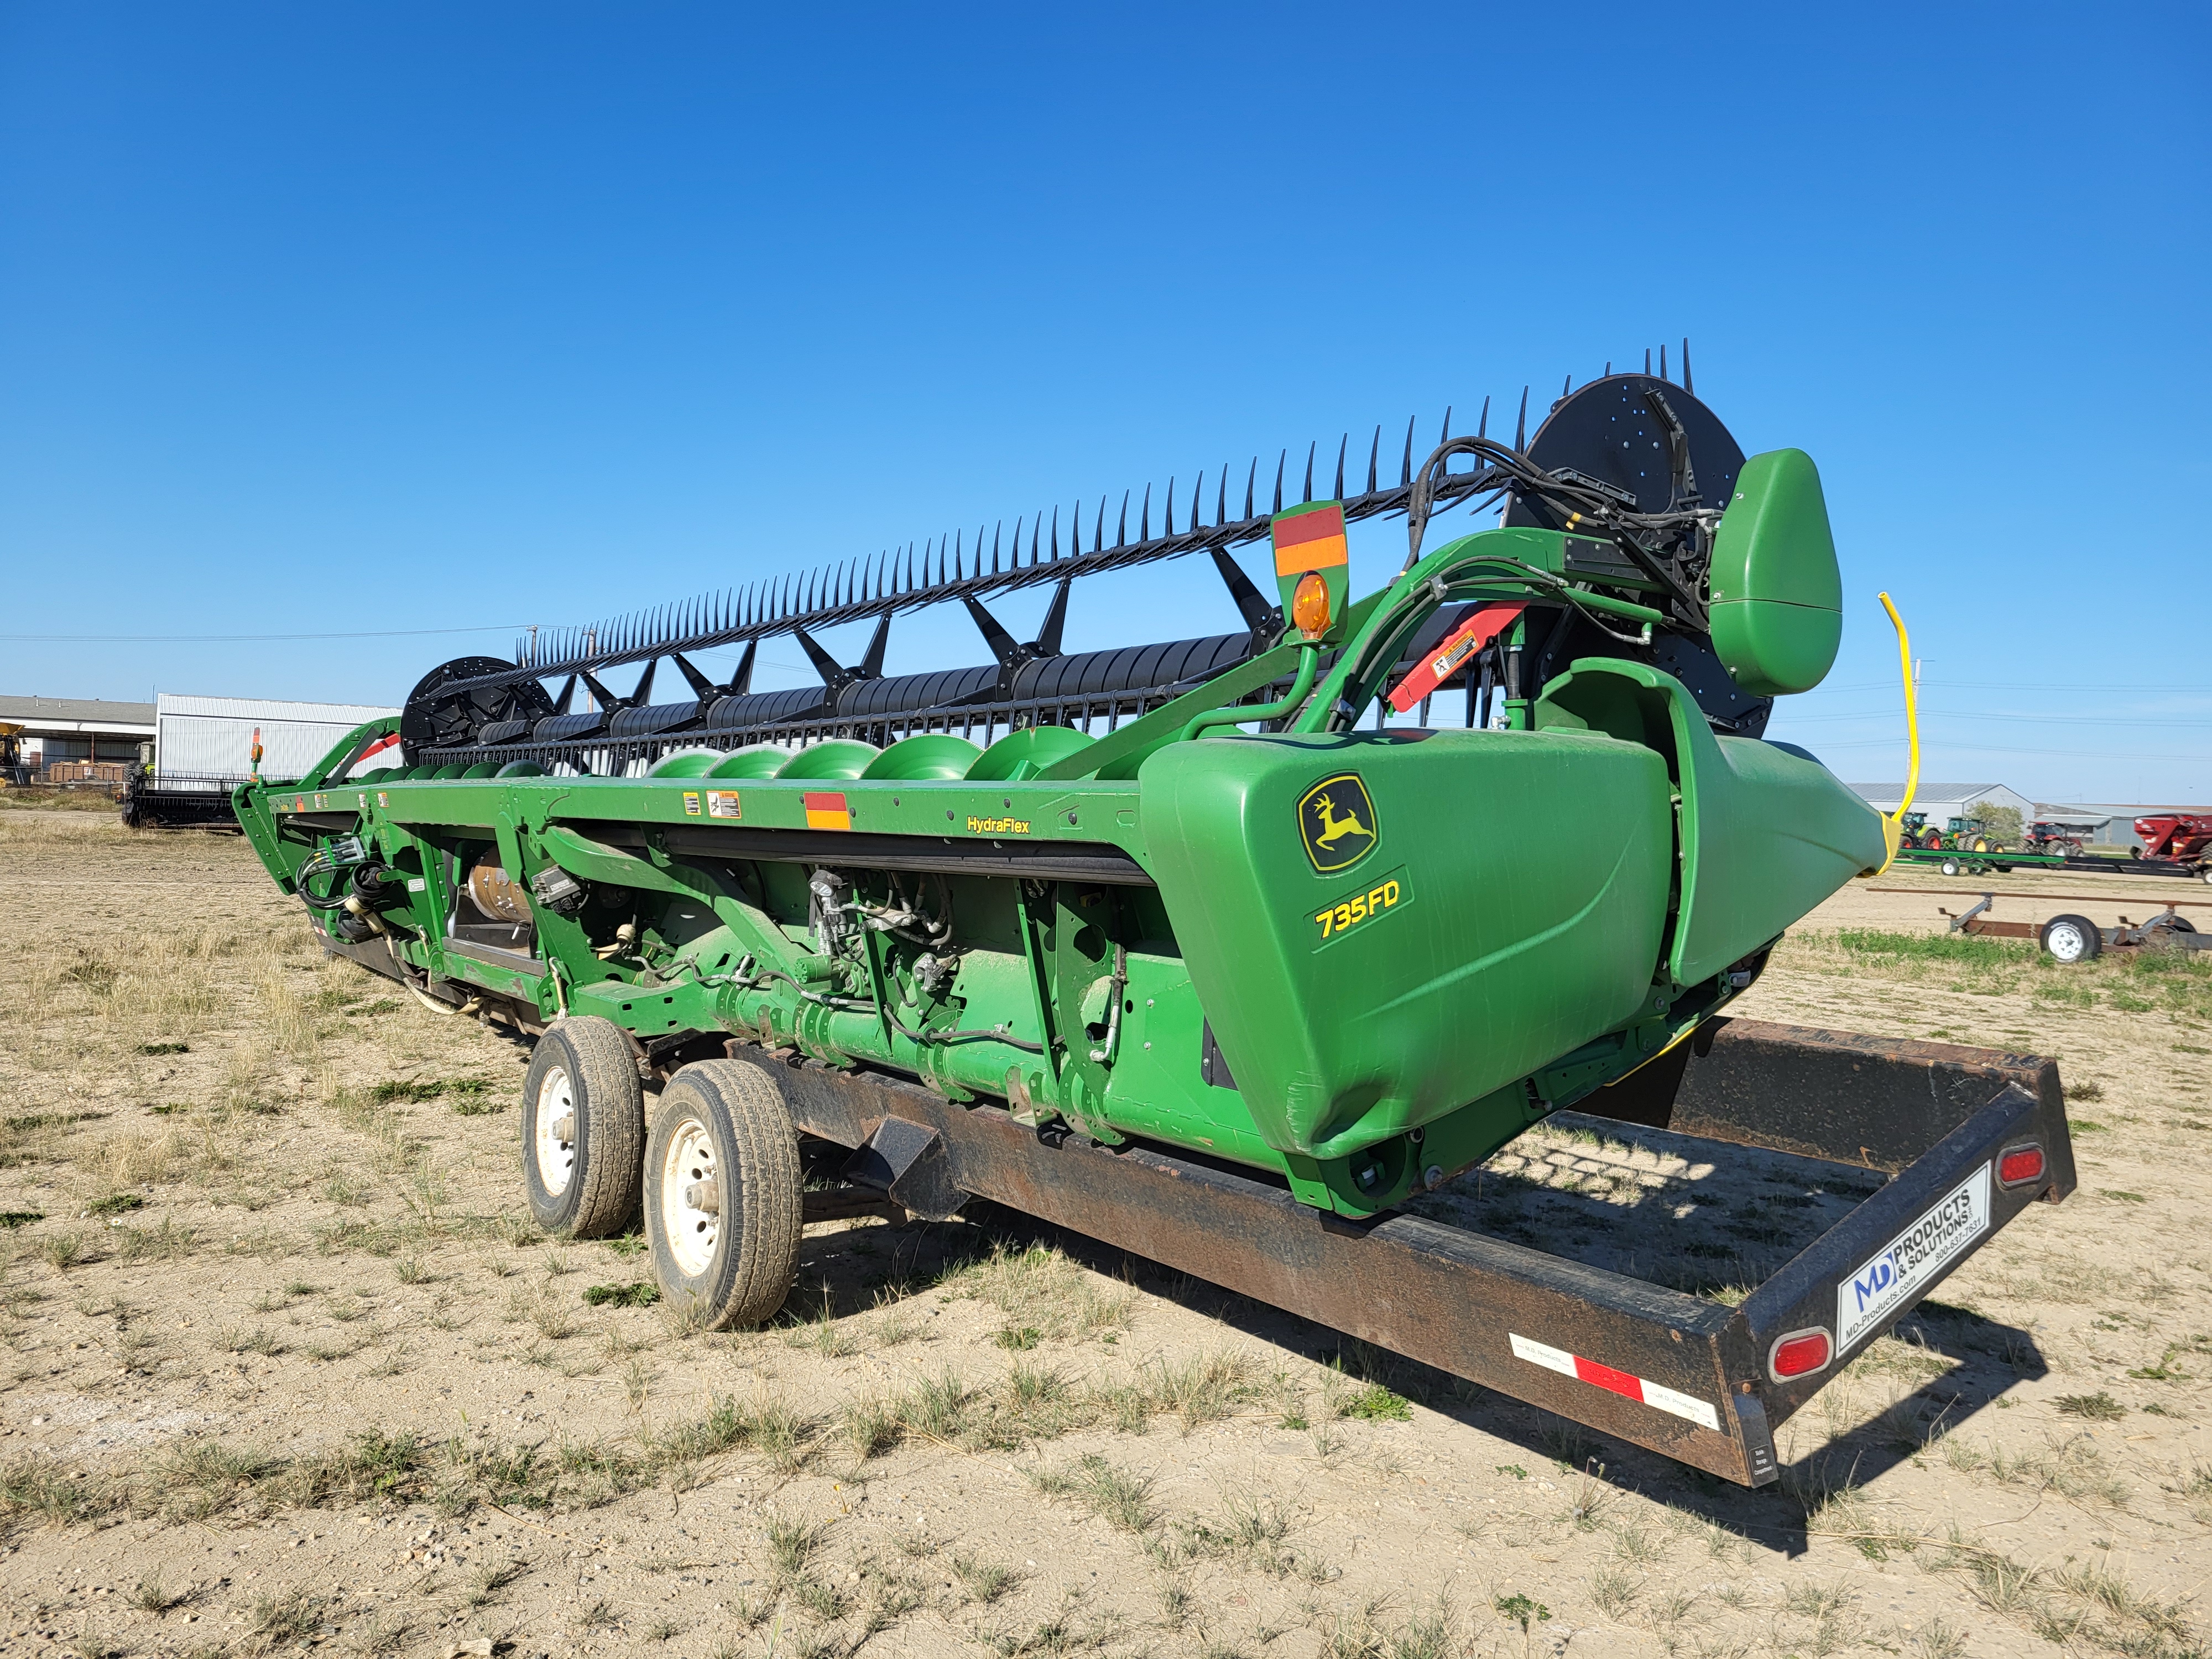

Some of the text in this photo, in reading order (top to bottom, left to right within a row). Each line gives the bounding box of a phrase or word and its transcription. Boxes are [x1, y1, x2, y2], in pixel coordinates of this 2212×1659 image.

[967, 816, 1031, 834] HydraFlex
[1314, 879, 1400, 940] 735FD
[1893, 1189, 1970, 1265] PRODUCTS
[1898, 1210, 1968, 1279] & SOLUTIONS
[1936, 1216, 1981, 1262] 800-637-7631
[1845, 1275, 1916, 1340] MD-Products.com
[1537, 1350, 1561, 1363] Products
[1672, 1398, 1699, 1412] Products
